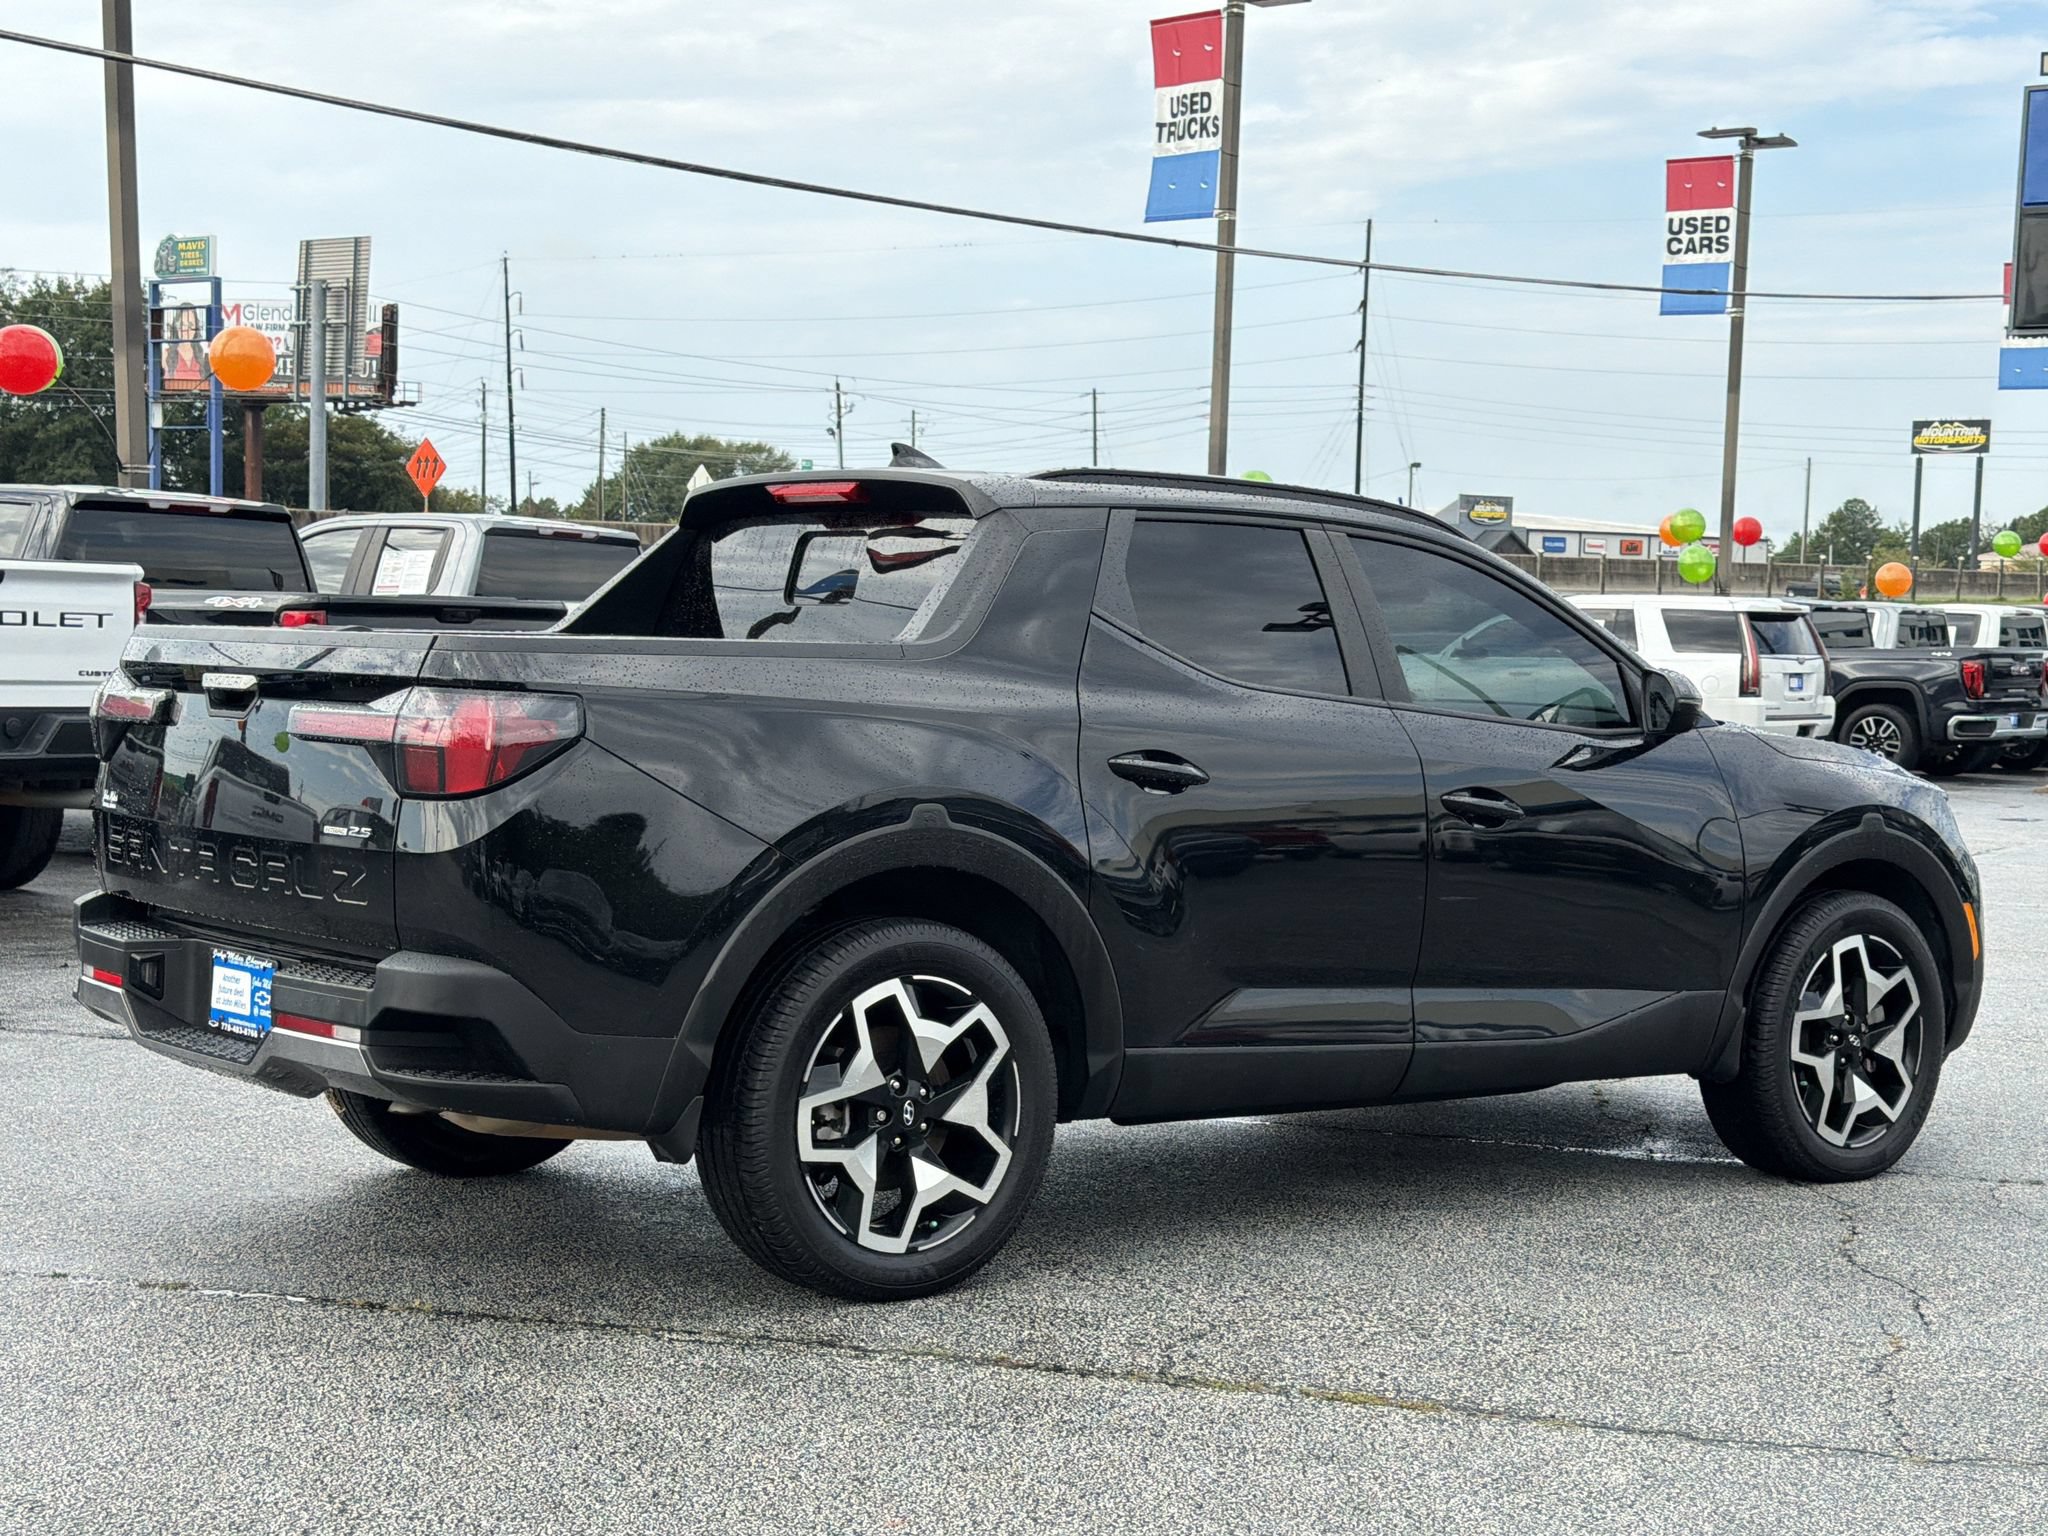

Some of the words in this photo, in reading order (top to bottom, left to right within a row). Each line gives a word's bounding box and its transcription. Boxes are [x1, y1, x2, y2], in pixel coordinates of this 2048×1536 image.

[1170, 91, 1212, 119] USED
[1156, 115, 1220, 143] TRUCKS
[1668, 215, 1730, 236] USED
[178, 240, 206, 250] MAVIS
[1666, 235, 1730, 255] CARS
[243, 303, 296, 321] Glend
[265, 323, 285, 331] FIRM
[1915, 435, 1986, 444] MOTORSPORTS
[1921, 427, 1982, 437] MOUNTAIN
[0, 610, 113, 628] OLET
